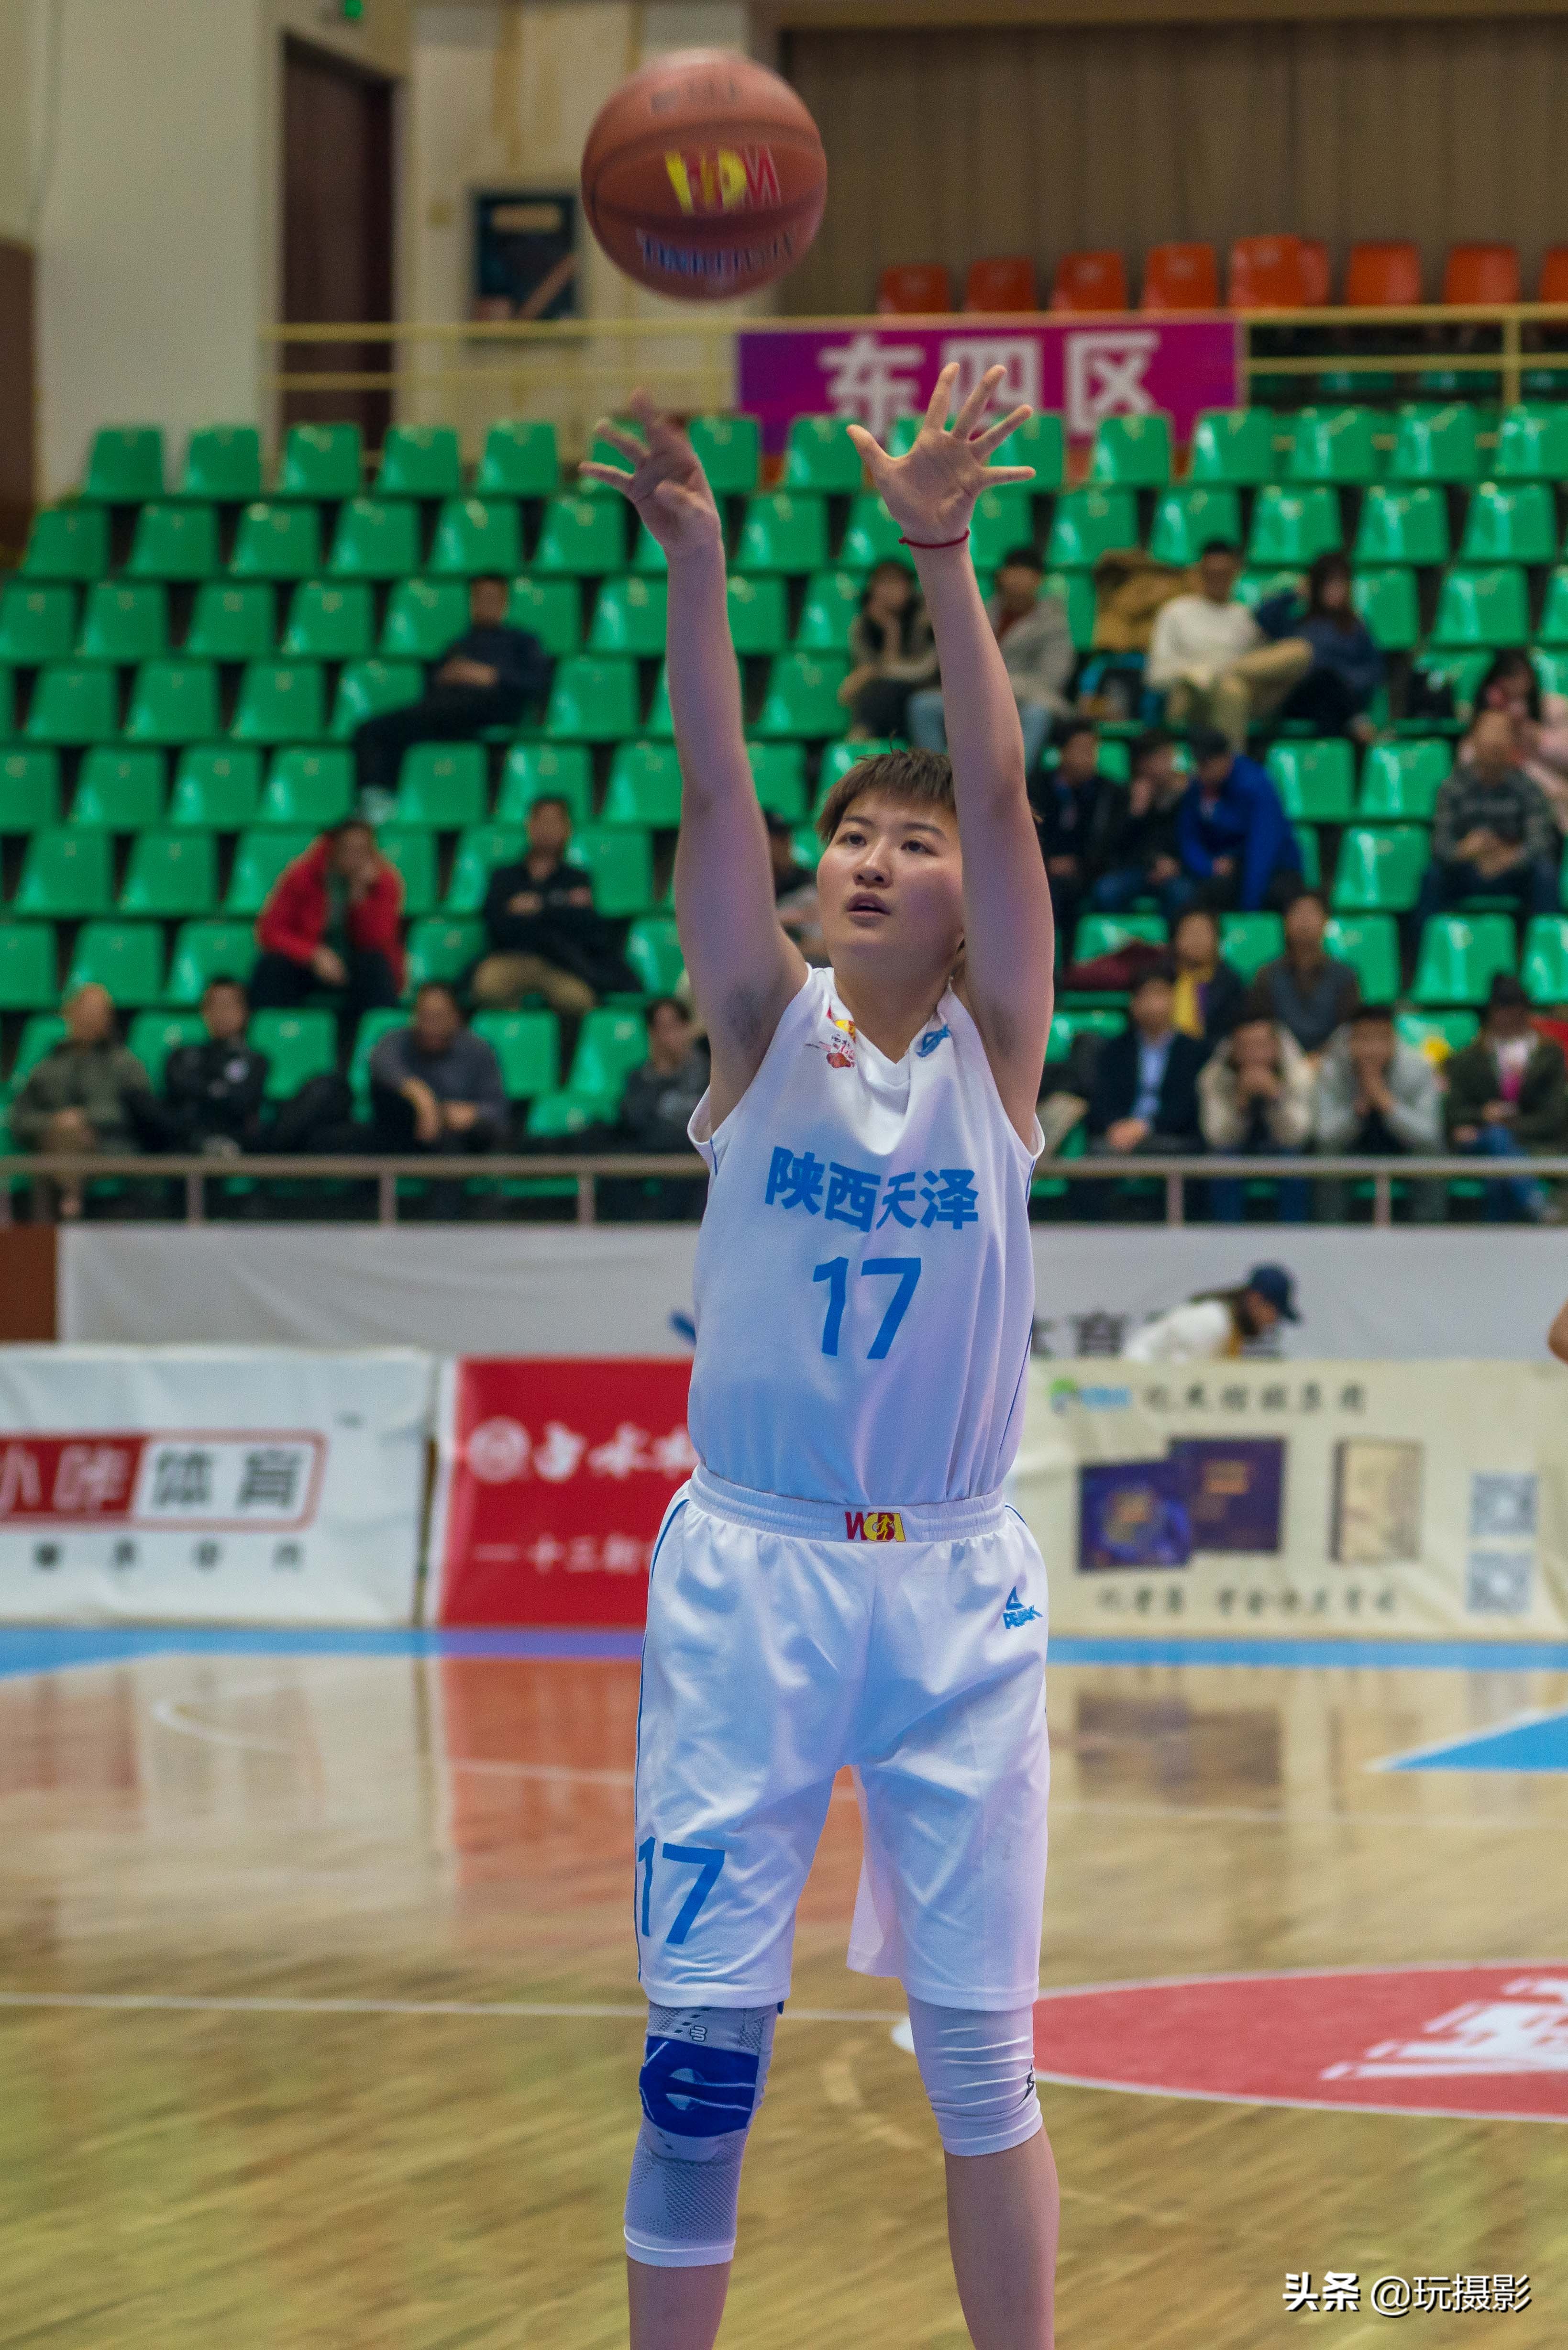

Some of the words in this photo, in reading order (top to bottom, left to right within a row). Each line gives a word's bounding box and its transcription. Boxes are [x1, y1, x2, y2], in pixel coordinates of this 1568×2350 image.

[817, 331, 1160, 443] 东四区
[765, 1145, 979, 1233] 陕西天泽
[812, 1256, 922, 1360] 17
[638, 1836, 726, 1945] 17
